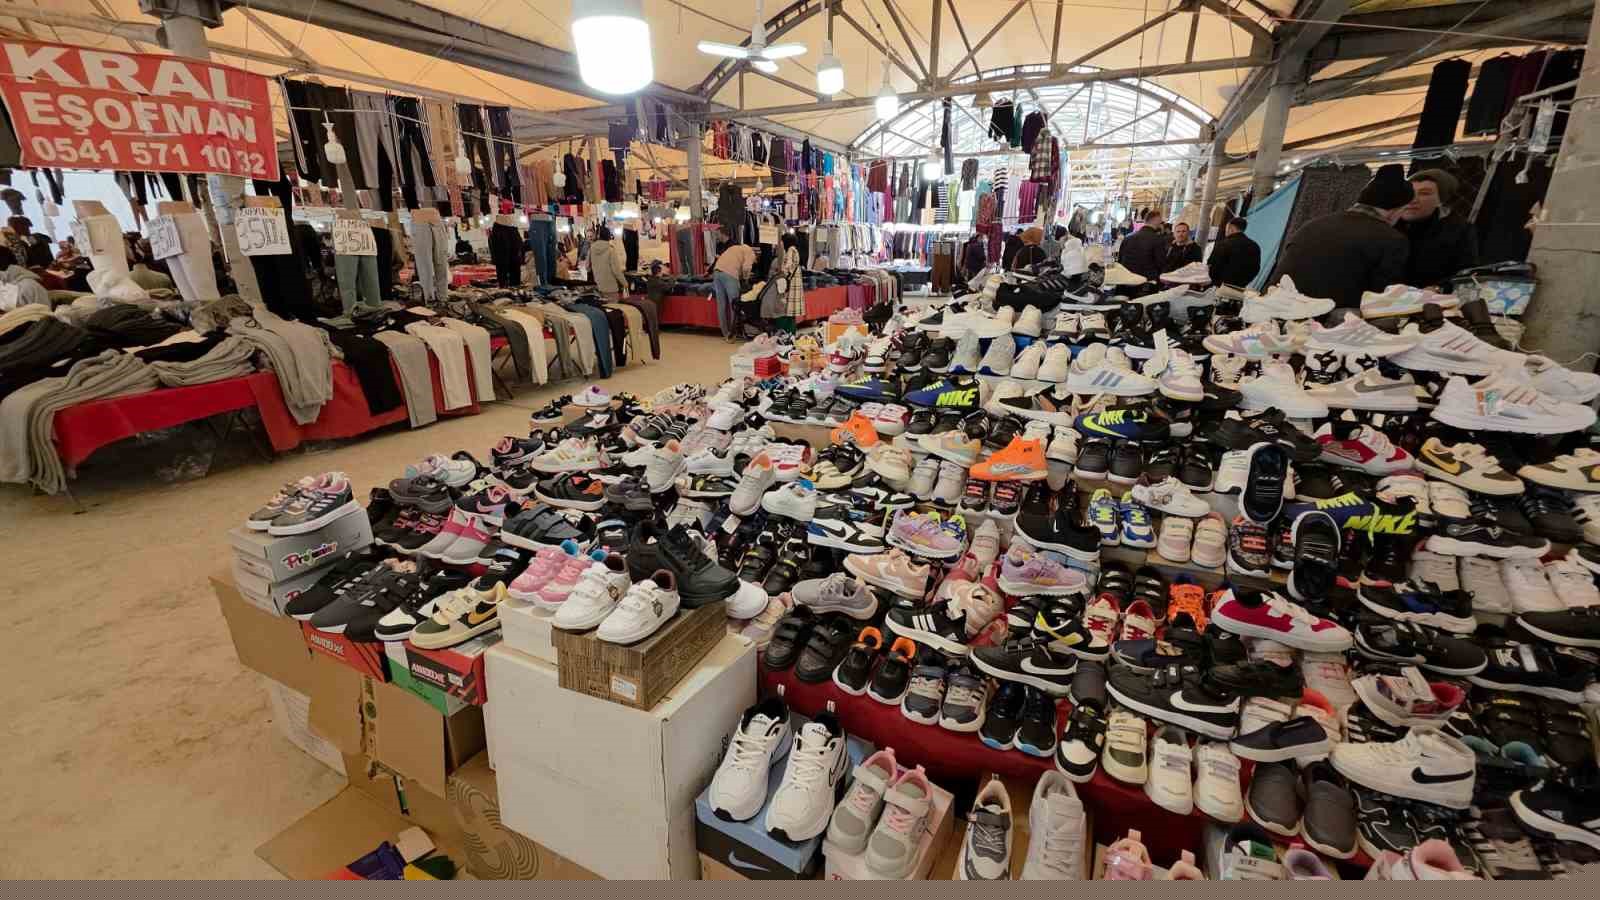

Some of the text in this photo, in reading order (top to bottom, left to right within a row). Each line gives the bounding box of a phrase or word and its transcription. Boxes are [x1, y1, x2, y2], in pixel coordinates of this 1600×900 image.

[3, 43, 252, 109] KRAL
[19, 91, 257, 143] EŞOFMAN
[31, 136, 266, 175] 0541 571 10 32
[935, 387, 978, 407] NIKE
